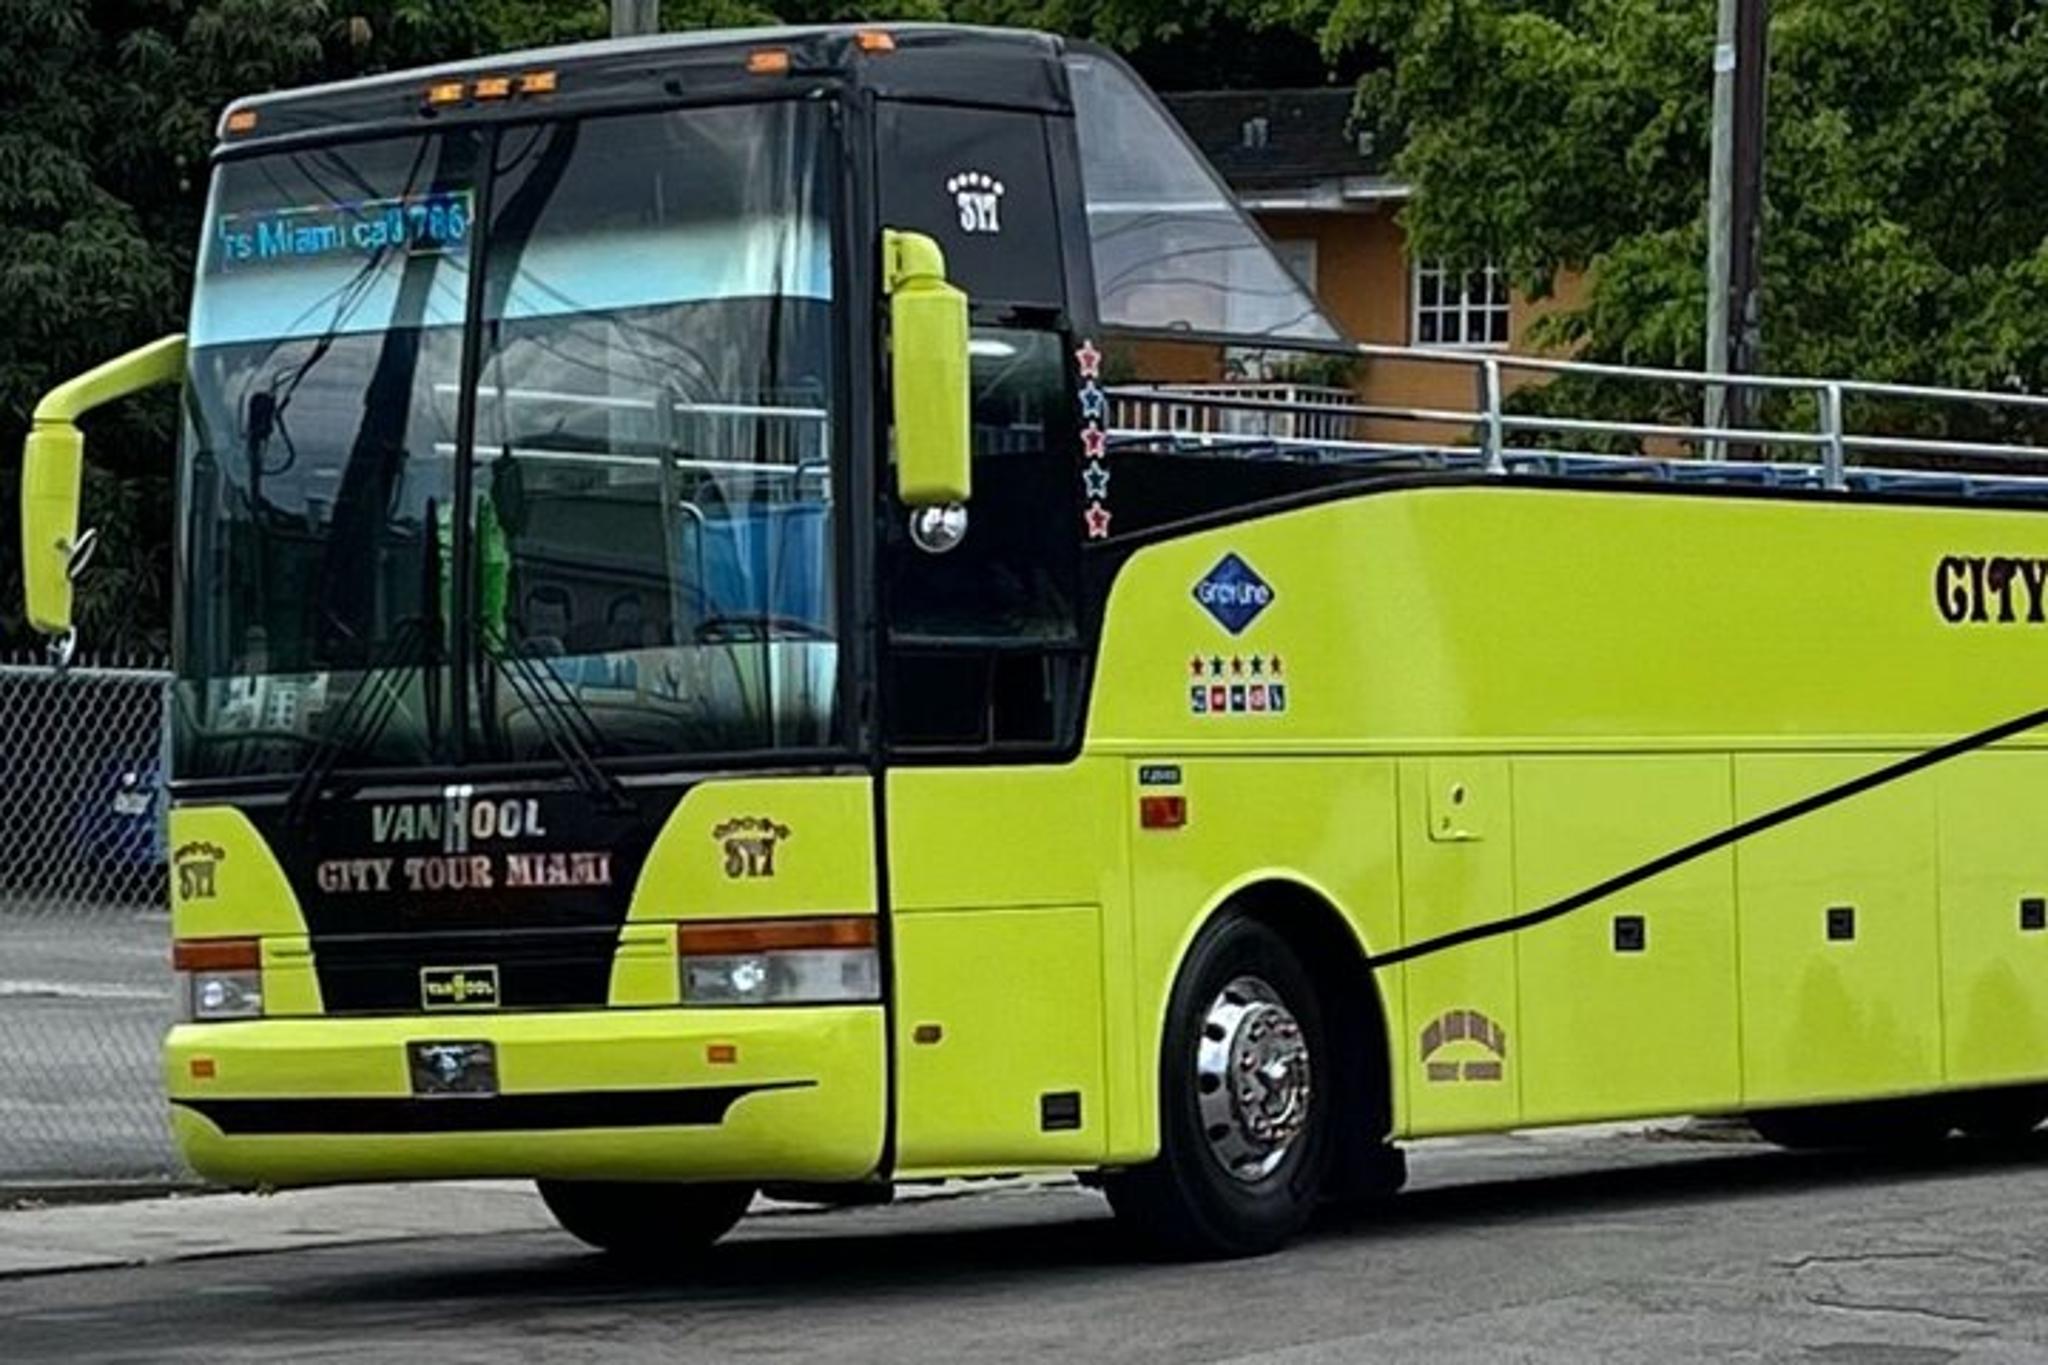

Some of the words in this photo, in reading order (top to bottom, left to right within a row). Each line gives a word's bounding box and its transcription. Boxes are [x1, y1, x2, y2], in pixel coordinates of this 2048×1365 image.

[256, 219, 347, 257] Miami
[408, 203, 467, 241] 786
[1935, 554, 2048, 624] CITY
[317, 858, 394, 892] CITY
[404, 854, 494, 890] TOUR
[505, 852, 613, 887] MIAMI
